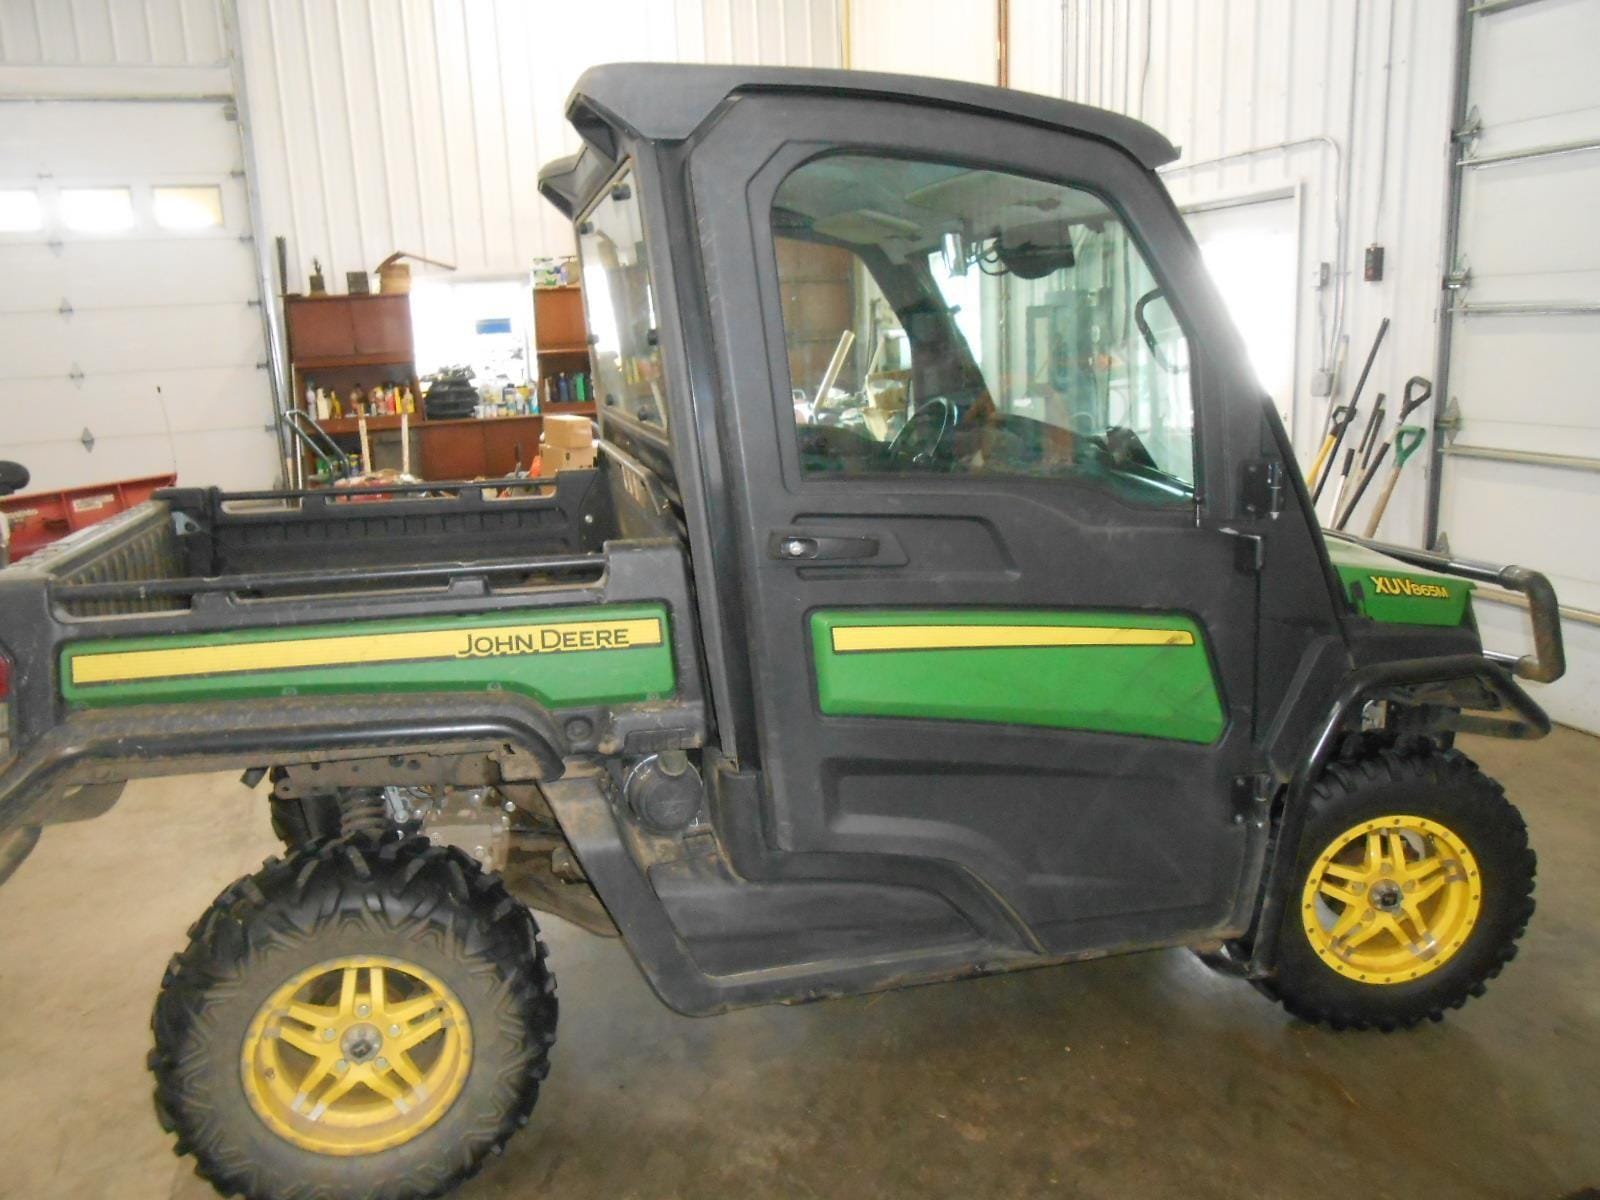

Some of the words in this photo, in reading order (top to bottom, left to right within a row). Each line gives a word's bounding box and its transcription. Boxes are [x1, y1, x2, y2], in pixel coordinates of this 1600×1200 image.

[1369, 576, 1449, 598] XUV865M
[458, 633, 533, 655] JOHN
[540, 628, 629, 649] DEERE
